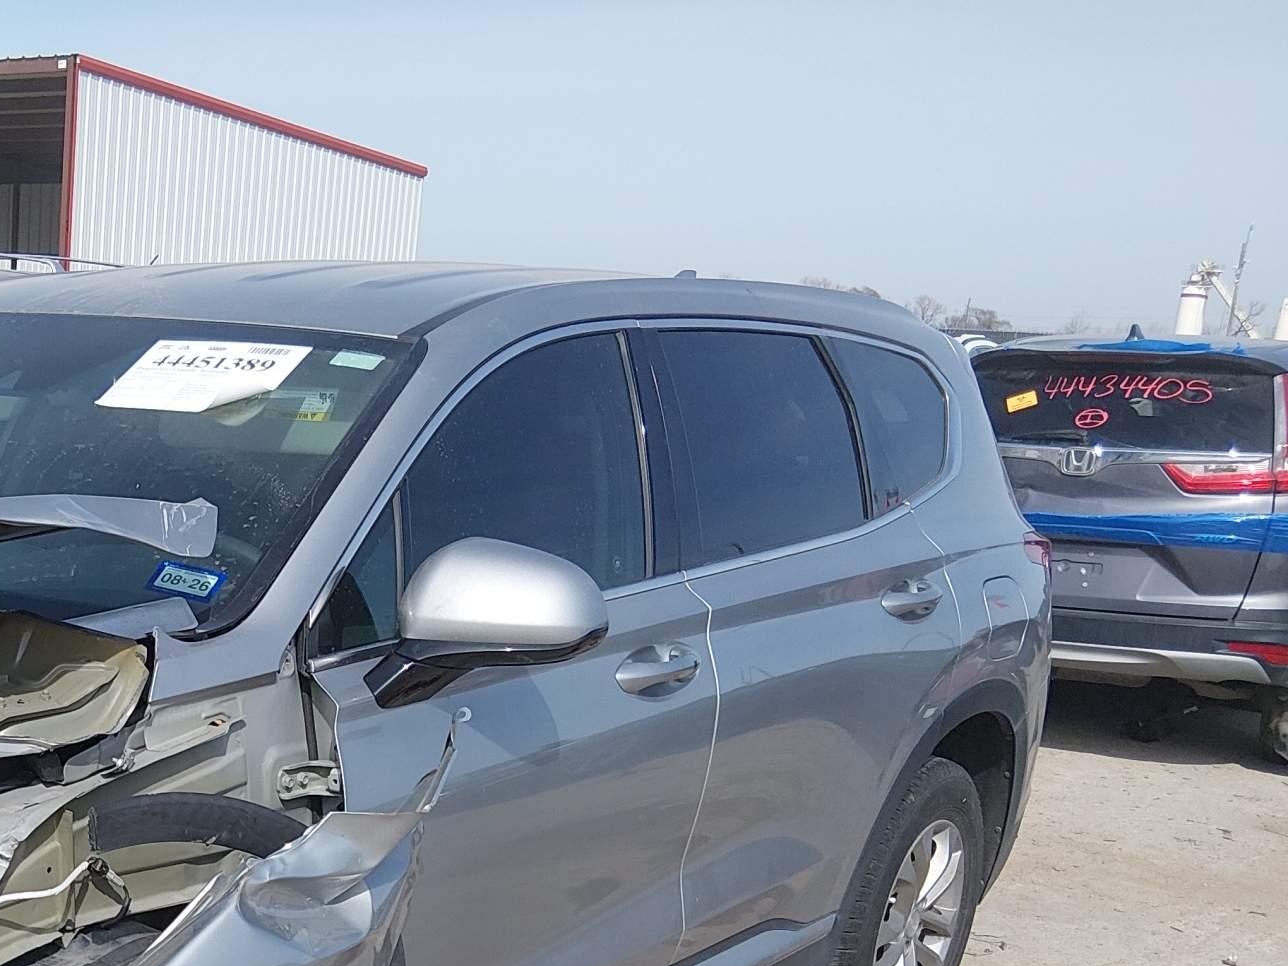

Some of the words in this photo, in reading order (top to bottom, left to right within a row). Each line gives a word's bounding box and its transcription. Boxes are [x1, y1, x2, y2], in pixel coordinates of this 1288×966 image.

[152, 355, 276, 371] 44451389
[1044, 374, 1213, 403] 44434405
[160, 572, 182, 585] 08
[188, 578, 211, 592] 26
